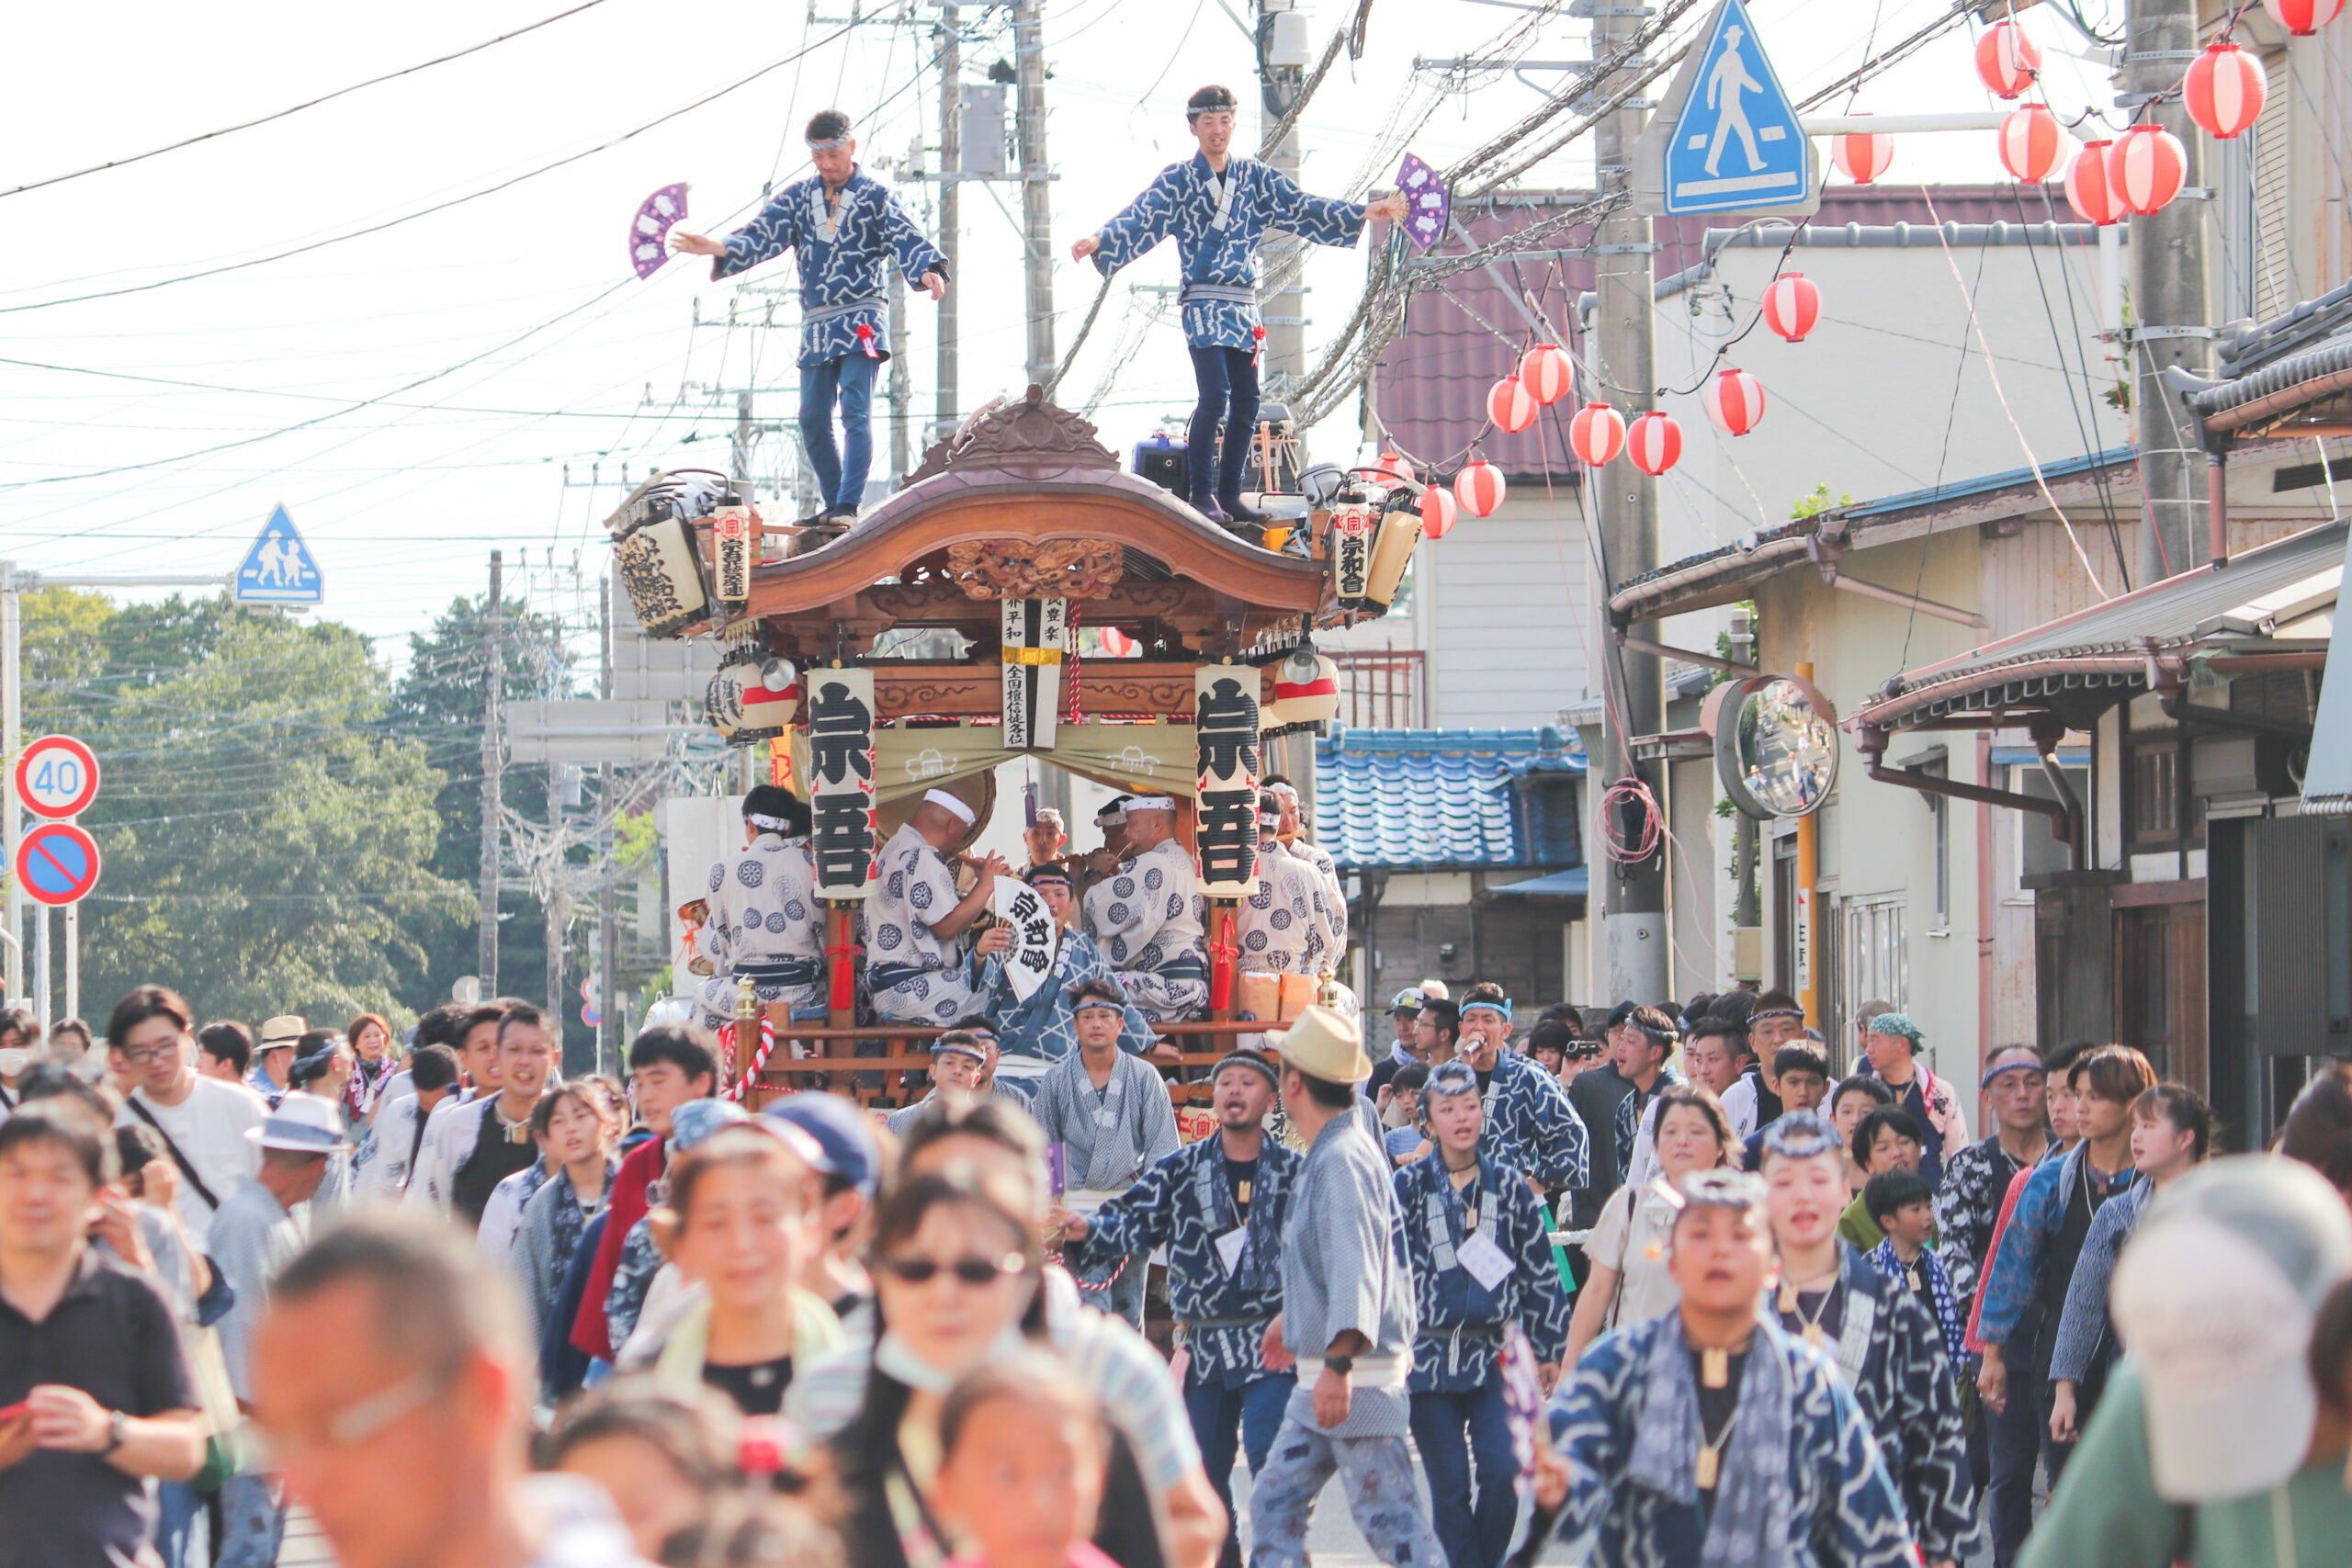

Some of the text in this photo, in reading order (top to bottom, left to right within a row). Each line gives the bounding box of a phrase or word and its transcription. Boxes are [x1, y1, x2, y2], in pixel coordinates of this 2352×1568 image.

[34, 761, 78, 795] 40
[809, 682, 874, 889] 宗吾
[1197, 678, 1260, 886] 宗吾
